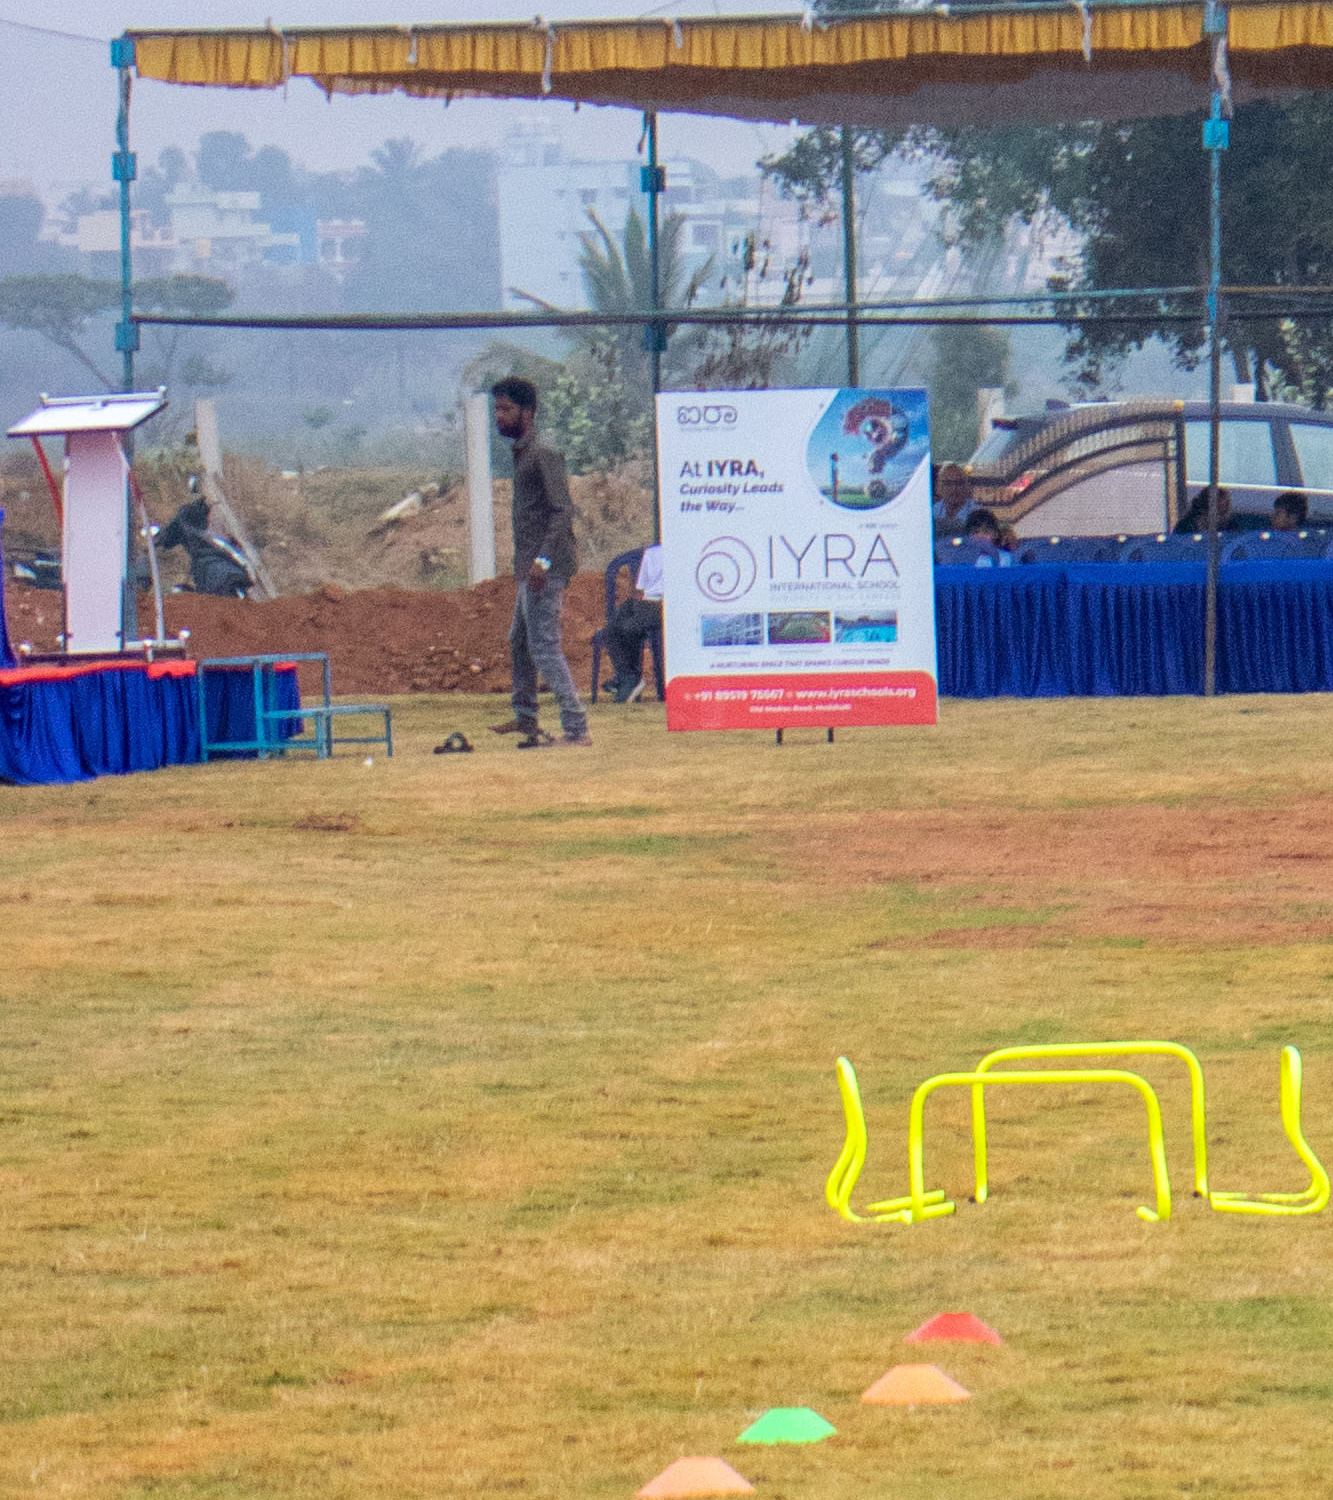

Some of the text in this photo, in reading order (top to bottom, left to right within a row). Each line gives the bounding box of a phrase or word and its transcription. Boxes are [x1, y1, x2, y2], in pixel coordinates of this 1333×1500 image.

[679, 459, 765, 479] At IYRA,
[679, 481, 784, 496] Curiosity Leads
[680, 500, 702, 513] the
[768, 532, 900, 580] IYRA
[769, 579, 900, 591] INTERNATIONAL SCHOOL
[797, 685, 917, 699] www.iyraschools.org
